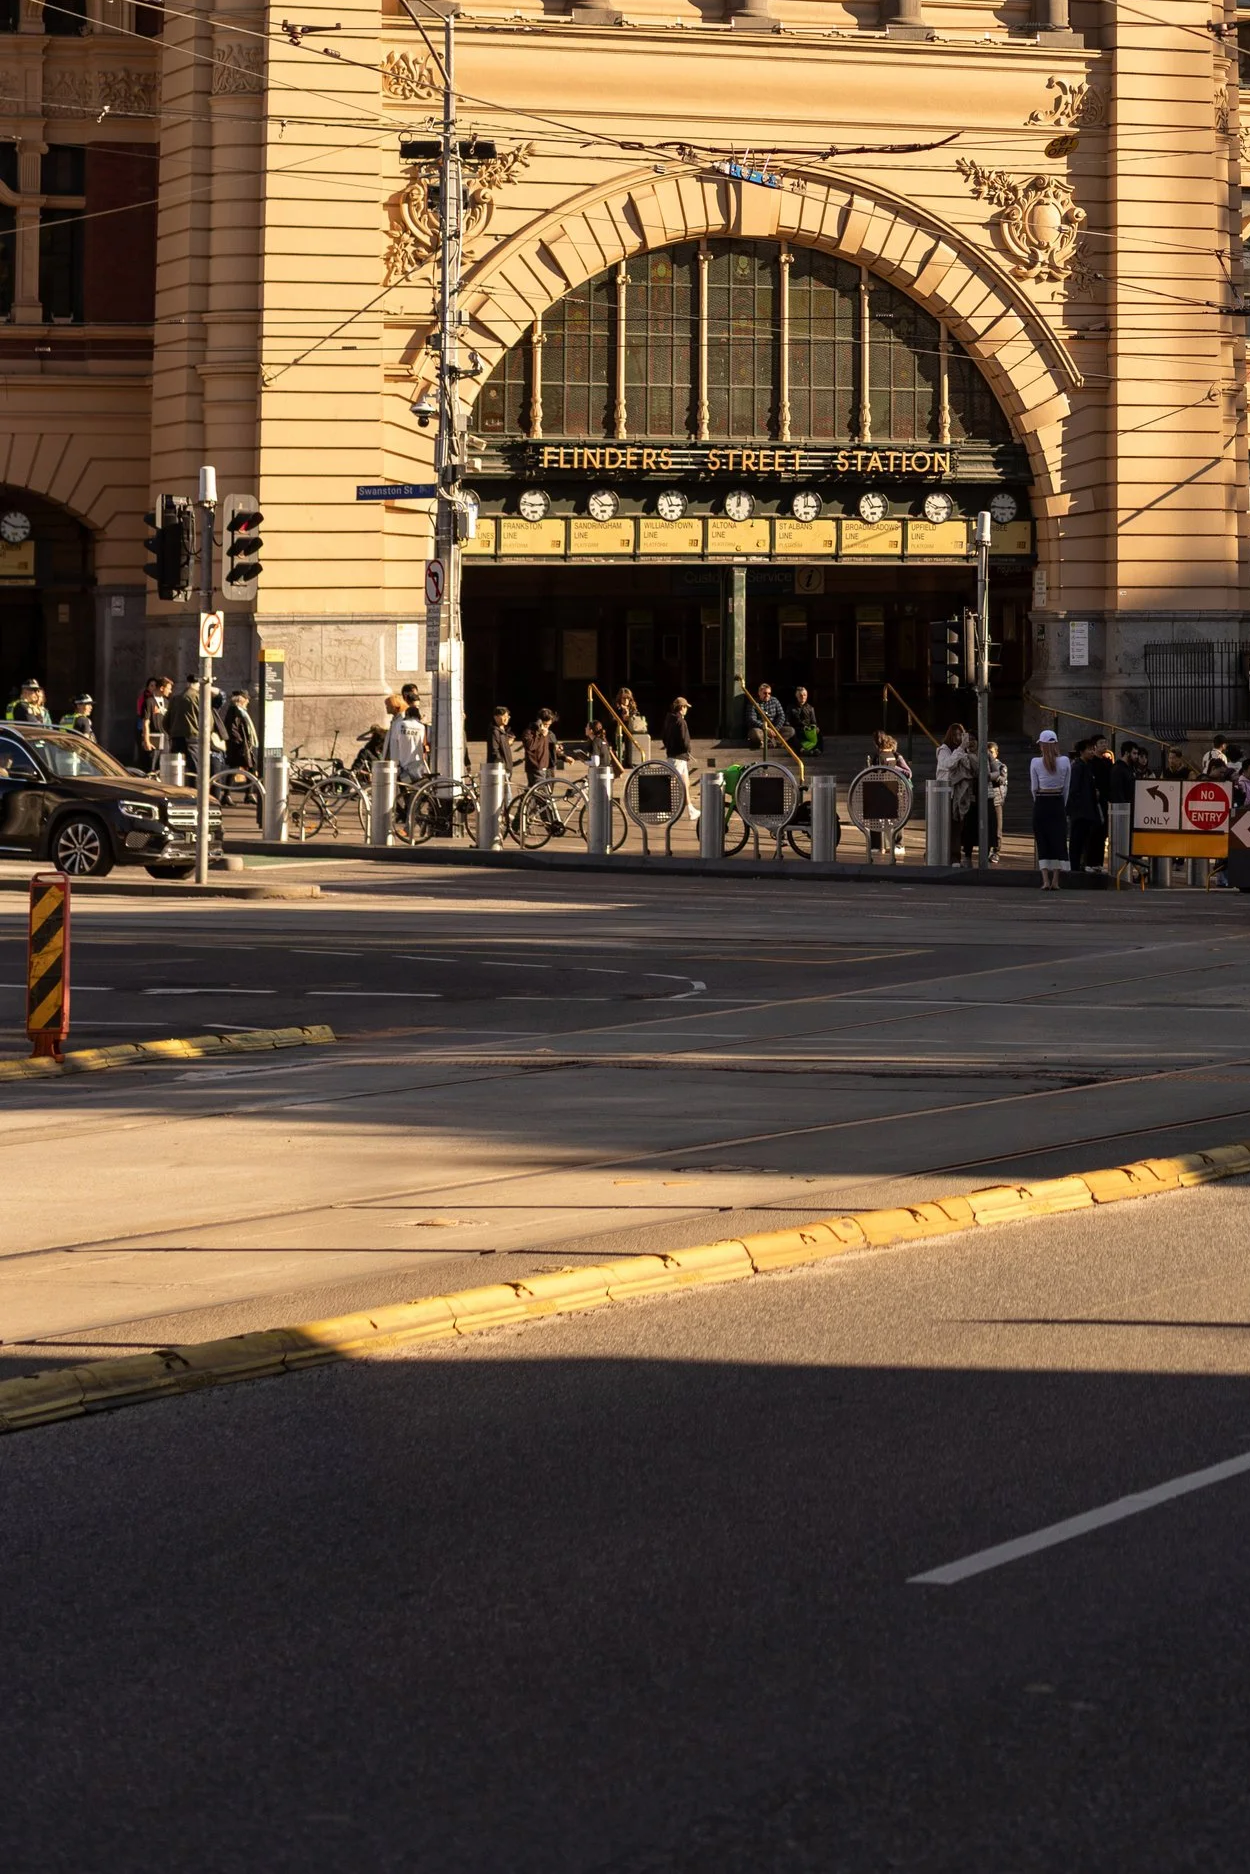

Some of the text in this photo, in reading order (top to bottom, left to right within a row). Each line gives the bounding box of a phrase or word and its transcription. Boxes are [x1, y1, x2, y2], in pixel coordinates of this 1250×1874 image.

[543, 446, 950, 473] FLINDERS STREET STATION
[359, 486, 413, 496] Swanston St
[574, 522, 622, 530] SANDRINGHAM
[911, 523, 936, 531] UPFIELD
[748, 570, 792, 583] Service
[1200, 790, 1215, 800] NO
[1143, 816, 1170, 825] ONLY
[1191, 812, 1223, 822] ENTRY
